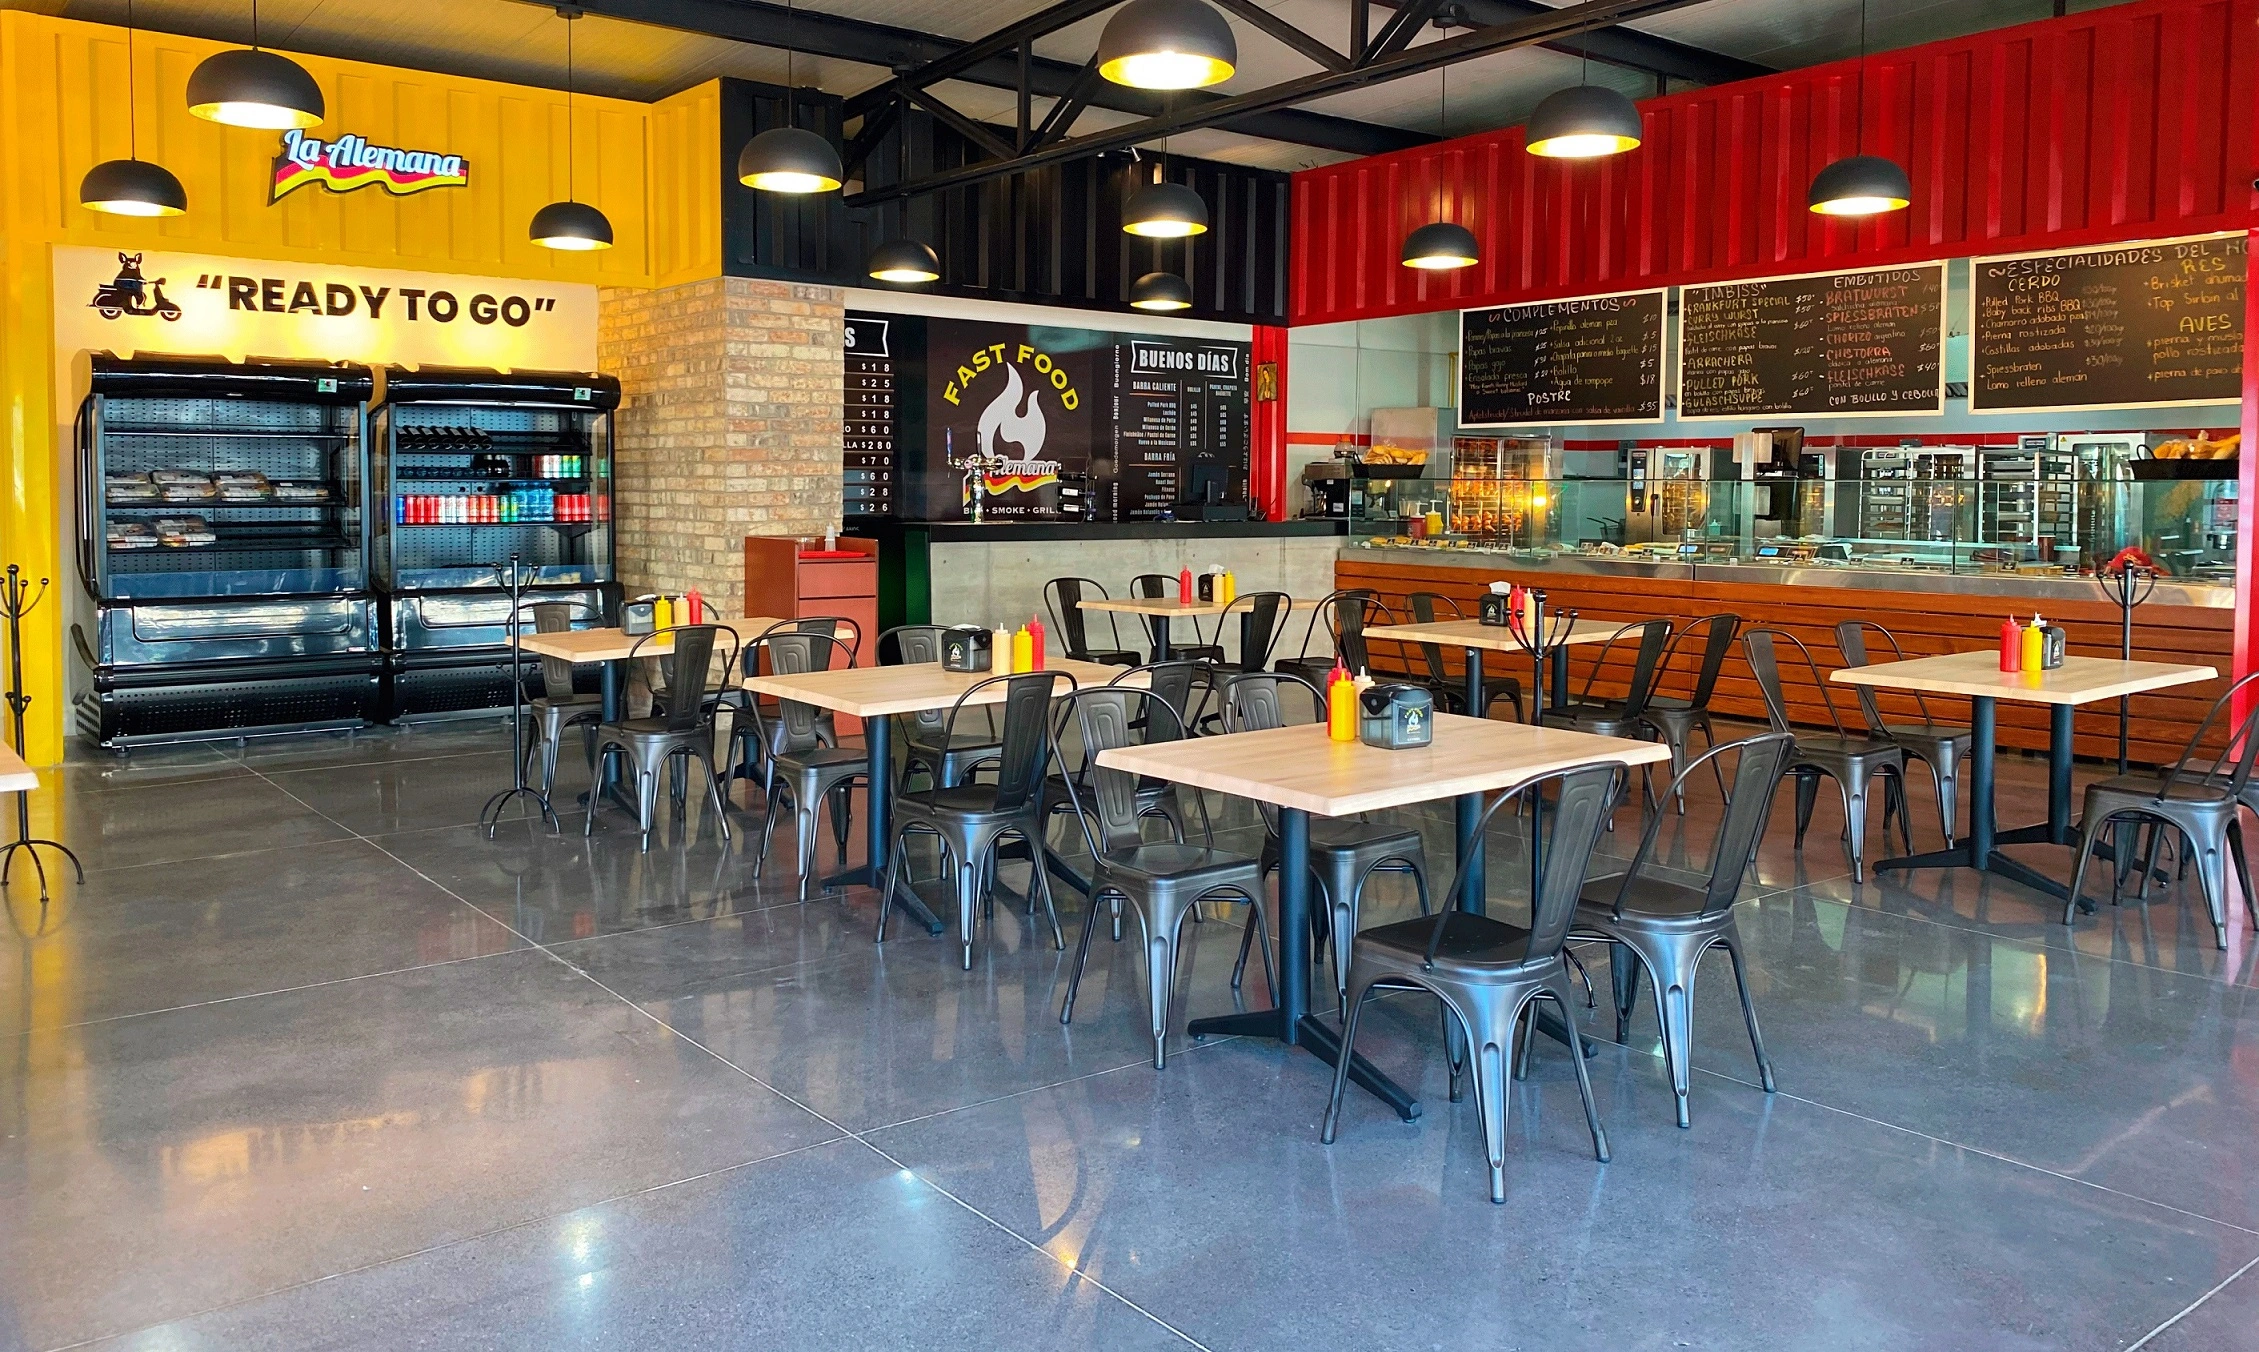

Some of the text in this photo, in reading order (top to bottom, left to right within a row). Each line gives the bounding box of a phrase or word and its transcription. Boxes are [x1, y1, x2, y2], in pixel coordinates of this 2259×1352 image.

[284, 129, 462, 177] La Alemana
[2174, 244, 2210, 259] DEL
[2180, 257, 2226, 274] RES
[1834, 269, 1921, 288] EMBUTIDOS
[2008, 274, 2061, 291] CERDO
[2150, 274, 2194, 290] Brisket
[1826, 285, 1908, 306] BRATWURST
[2014, 294, 2033, 304] Pork
[2038, 291, 2059, 303] BBQ
[400, 288, 459, 323] TO
[1503, 298, 1620, 323] COMPLEMENTOS
[1687, 298, 1747, 315] FRANKFURT
[1752, 296, 1791, 308] SPECIAL
[1986, 307, 2006, 320] Baby
[2011, 305, 2031, 315] back
[2037, 304, 2055, 314] ribs
[2060, 298, 2081, 312] BBQ
[2152, 296, 2174, 312] Top
[1688, 312, 1719, 325] CURRY
[1724, 308, 1759, 320] WURST
[1825, 304, 1918, 324] SPIESSBRATEN
[1985, 318, 2028, 329] Chamorro
[2029, 313, 2066, 324] adobado
[2180, 313, 2232, 333] AVES
[1826, 331, 1872, 345] CHORIZO
[1985, 325, 2066, 341] Pierna rostizada
[1553, 339, 1570, 349] Salsa
[2028, 338, 2075, 352] adobadas
[1139, 349, 1229, 372] BUENOS DÍAS
[1687, 353, 1753, 369] ARRACHERA
[943, 342, 1079, 411] FAST FOOD
[1986, 361, 2042, 379] Spiessbraten
[1132, 381, 1176, 392] BARRA CALIENTE
[1639, 373, 1656, 386] $18
[1686, 373, 1759, 391] PULLED PORK
[1987, 379, 2009, 390] Lomo
[1527, 390, 1571, 406] POSTRE
[1637, 400, 1658, 412] $35
[1685, 392, 1763, 408] GULASCHSUPPE
[1829, 395, 1846, 406] CON
[1144, 452, 1161, 461] BARRA
[991, 506, 1025, 514] SMOKE
